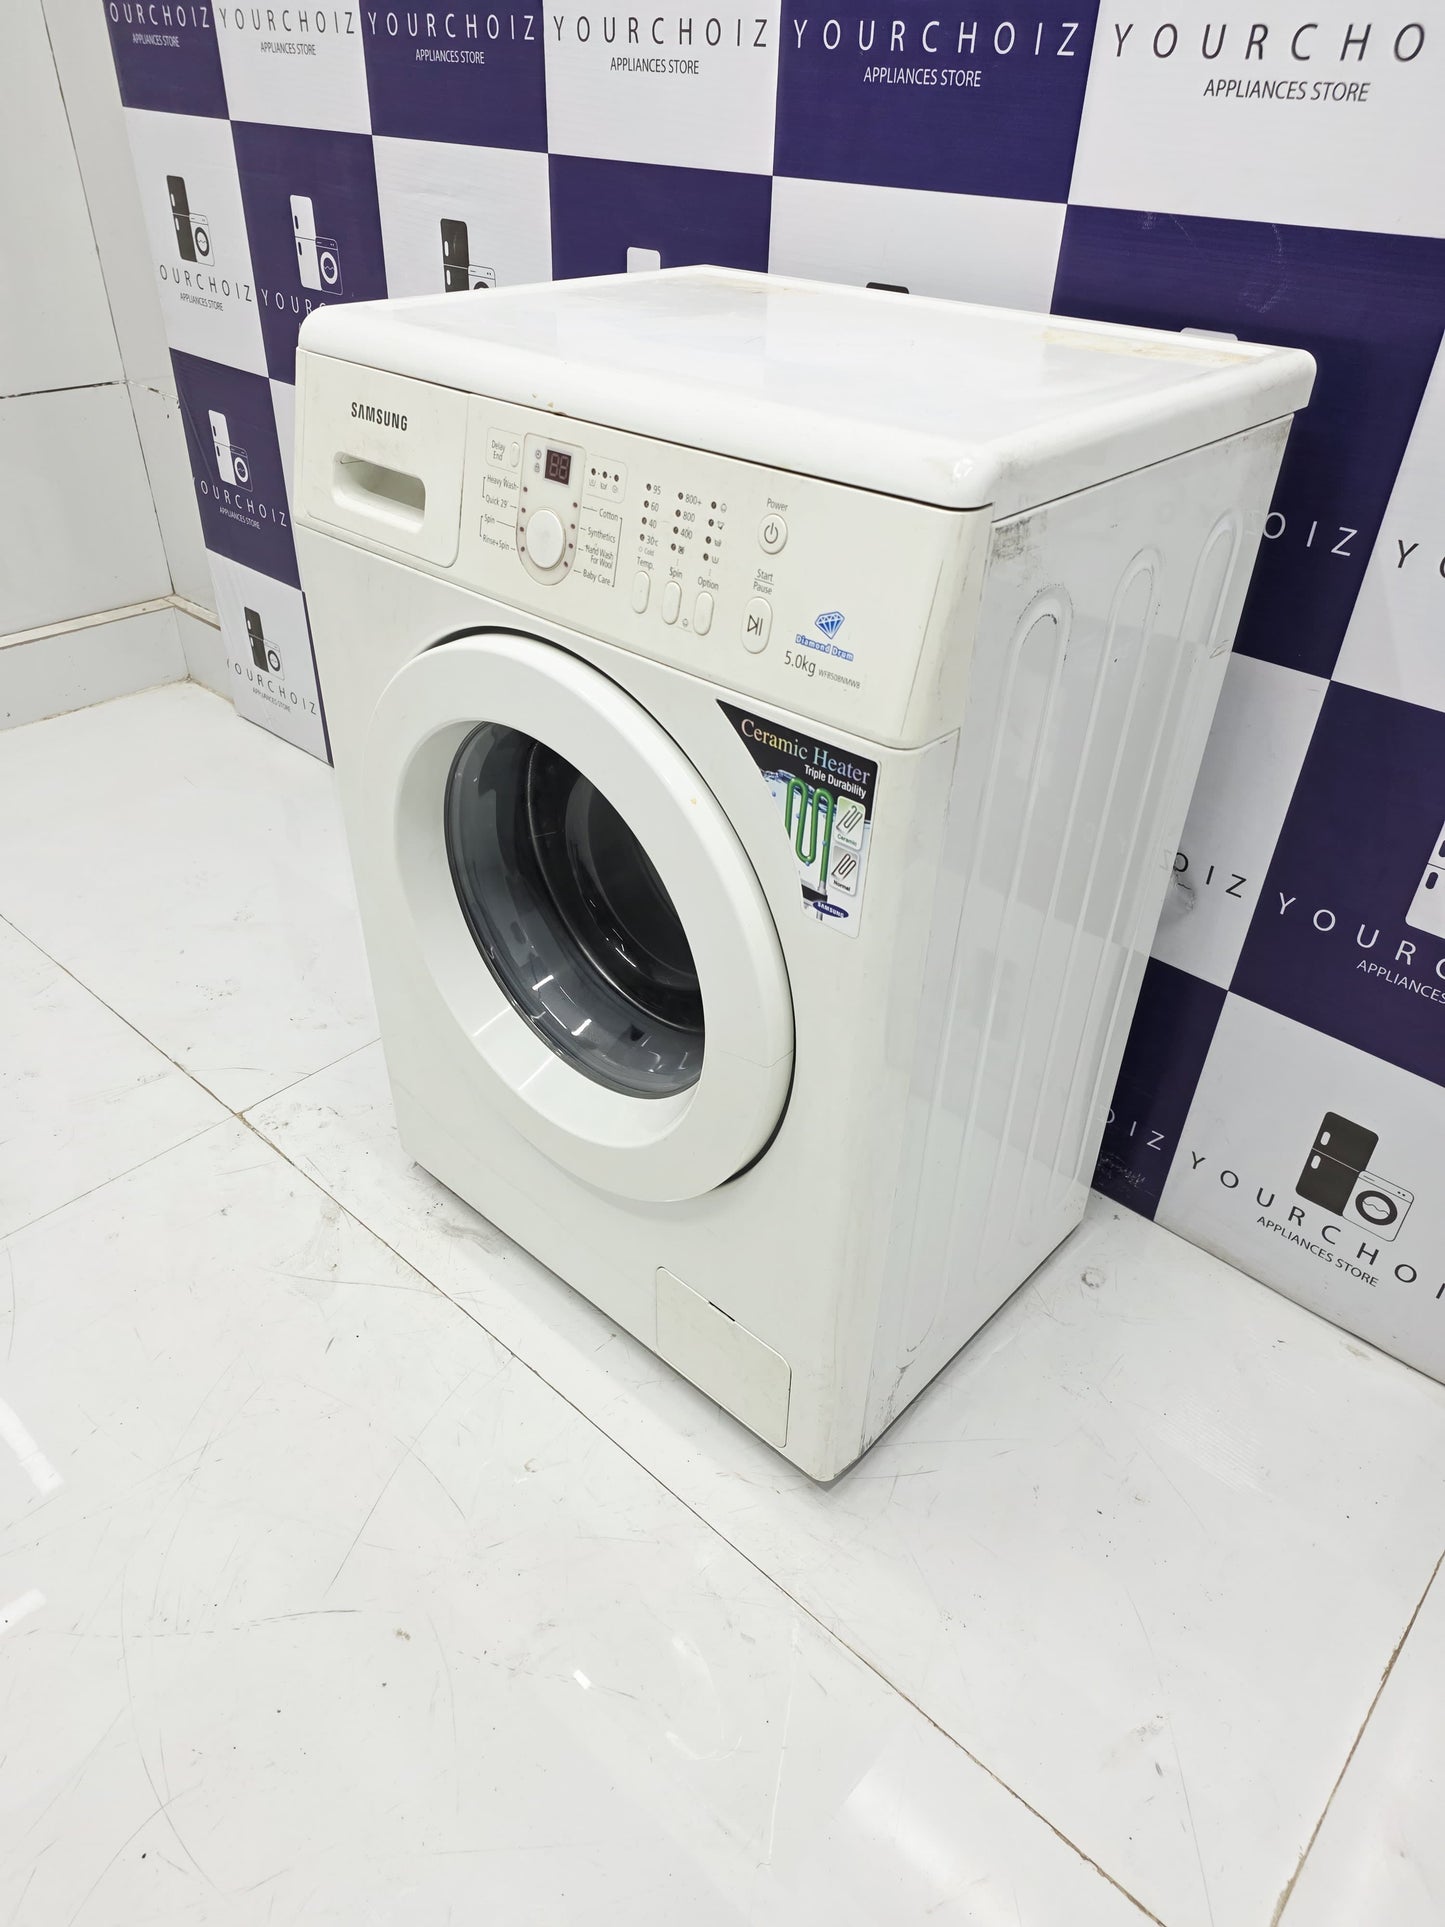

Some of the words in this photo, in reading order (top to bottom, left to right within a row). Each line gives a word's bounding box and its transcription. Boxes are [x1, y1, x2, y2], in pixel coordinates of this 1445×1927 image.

[218, 7, 355, 34] YOURCHOIZ
[368, 12, 535, 41] YOURCHOIZ
[553, 15, 768, 48] YOURCHOIZ
[793, 19, 1079, 57] YOURCHOIZ
[132, 33, 162, 46] APPLIANCES
[162, 35, 180, 47] STORE
[1114, 23, 1426, 63] YOURCHO
[260, 41, 296, 55] APPLIANCES
[297, 43, 316, 56] STORE
[415, 49, 459, 63] APPLIANCES
[460, 51, 485, 65] STORE
[610, 57, 666, 73] APPLIANCES
[668, 59, 700, 75] STORE
[863, 66, 938, 86] APPLIANCES
[940, 69, 982, 88] STORE
[1203, 78, 1307, 100] APPLIANCES
[1310, 82, 1371, 102] STORE
[180, 292, 208, 309] APPLIANCES
[207, 299, 224, 311] STORE
[261, 288, 326, 315] YOUR
[351, 401, 408, 431] SAMSUNG
[491, 439, 506, 455] Delay
[493, 451, 503, 461] End
[487, 474, 502, 488] Heavy
[503, 478, 517, 491] Wash
[653, 485, 661, 495] 95
[485, 494, 499, 506] Quick
[650, 502, 659, 512] 60
[685, 493, 702, 506] 800+
[766, 497, 788, 512] Power
[484, 514, 496, 524] Spin
[599, 508, 619, 521] Cotton
[682, 511, 695, 523] 800
[648, 519, 657, 529] 40
[587, 526, 616, 544] Synthetics
[680, 528, 693, 540] 400
[590, 554, 599, 565] For
[599, 558, 613, 570] Wool
[599, 548, 614, 560] Wash
[636, 556, 654, 570] Temp.
[582, 569, 597, 583] Baby
[597, 574, 611, 586] Care
[669, 566, 683, 580] Spin
[756, 568, 774, 583] Start
[697, 576, 719, 592] Option
[753, 581, 773, 595] Pause
[795, 634, 831, 653] Diamond
[831, 645, 854, 662] Drum
[784, 650, 816, 677] 5.0kg
[741, 718, 808, 760] Ceramic
[813, 746, 871, 785] Heater
[804, 764, 827, 782] Triple
[827, 775, 867, 800] Durability
[836, 833, 857, 847] Ceramic
[833, 879, 851, 892] Normal
[817, 902, 845, 918] SAMSUNG
[1256, 1215, 1334, 1263] APPLIANCES
[1335, 1258, 1380, 1288] STORE
